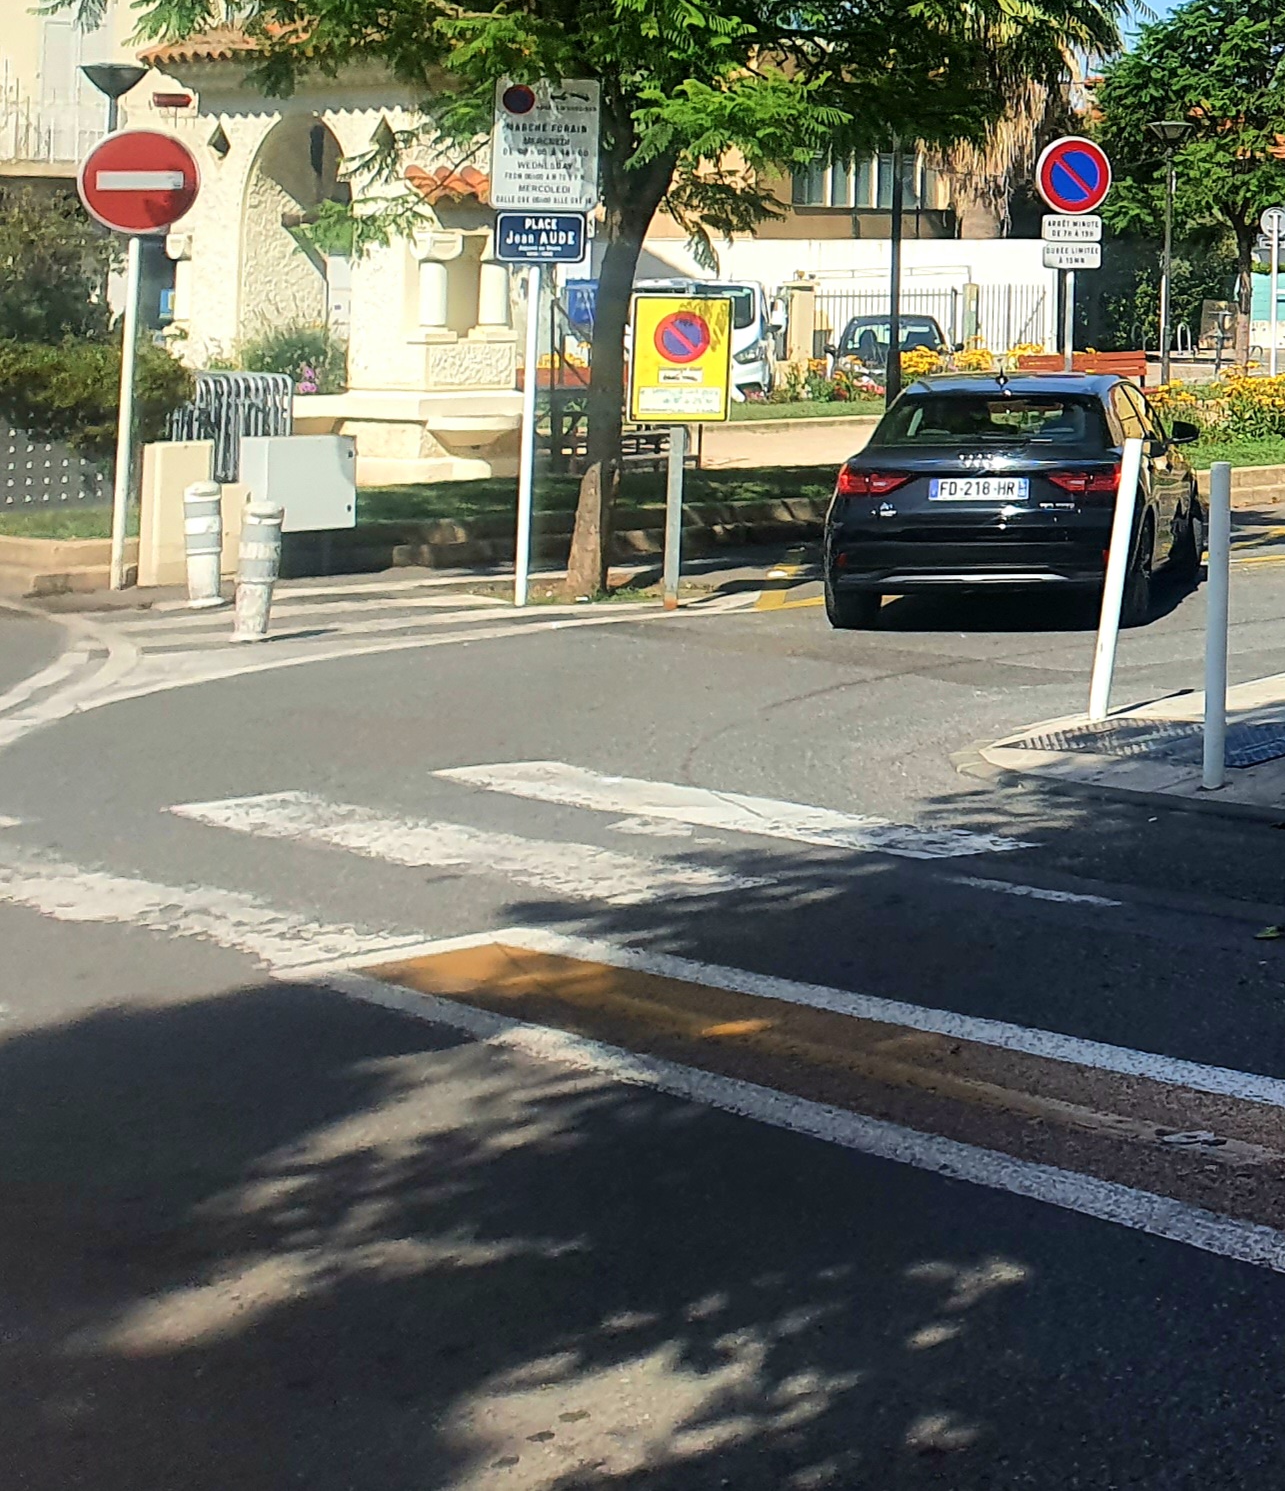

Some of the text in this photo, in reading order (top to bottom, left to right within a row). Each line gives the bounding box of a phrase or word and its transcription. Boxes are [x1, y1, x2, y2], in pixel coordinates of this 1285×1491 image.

[525, 217, 558, 230] PLACE
[506, 230, 575, 245] Jean AUDE
[940, 480, 1015, 496] FD-218-HR
